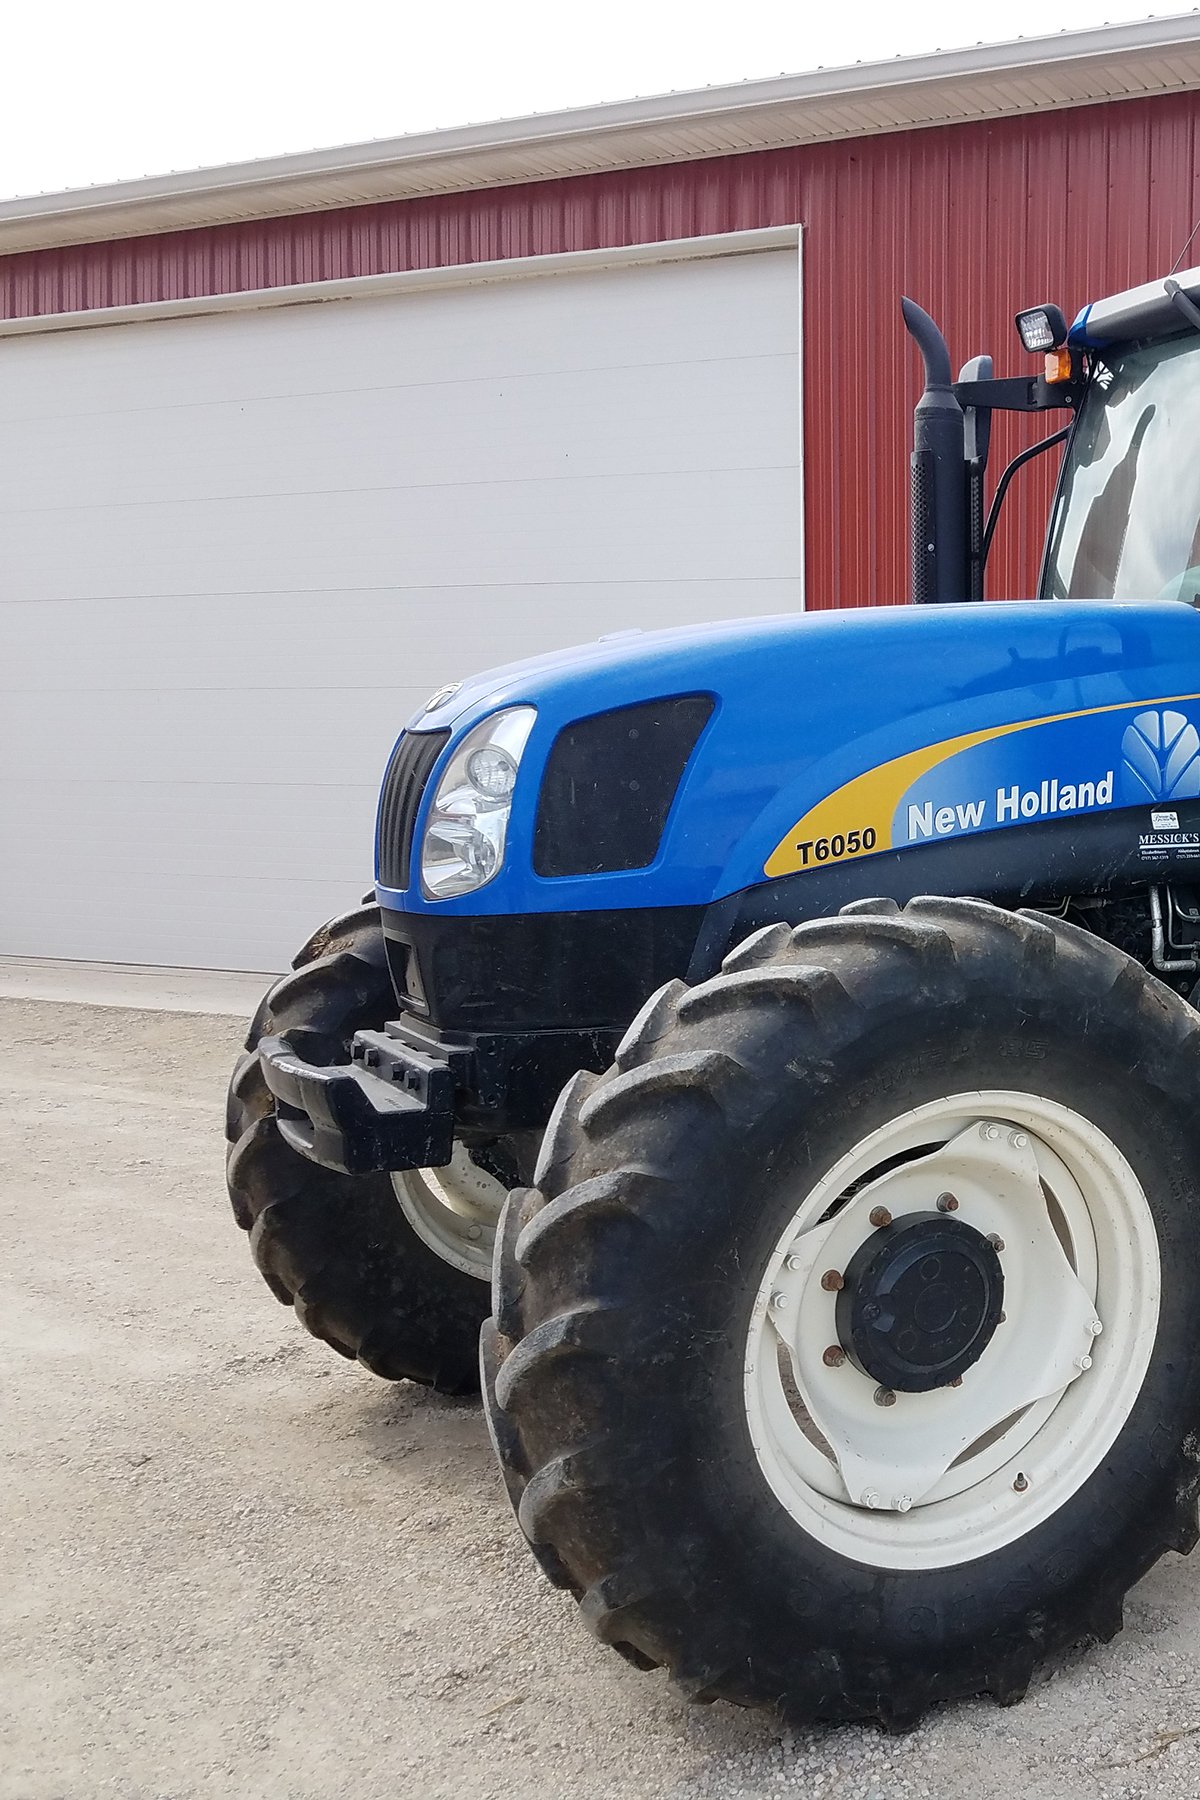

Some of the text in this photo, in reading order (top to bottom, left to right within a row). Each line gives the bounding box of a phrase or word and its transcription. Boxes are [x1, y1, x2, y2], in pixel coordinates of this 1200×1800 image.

[907, 771, 1115, 840] New Holland
[796, 828, 877, 864] T6050
[1138, 832, 1200, 845] MESSICK'S
